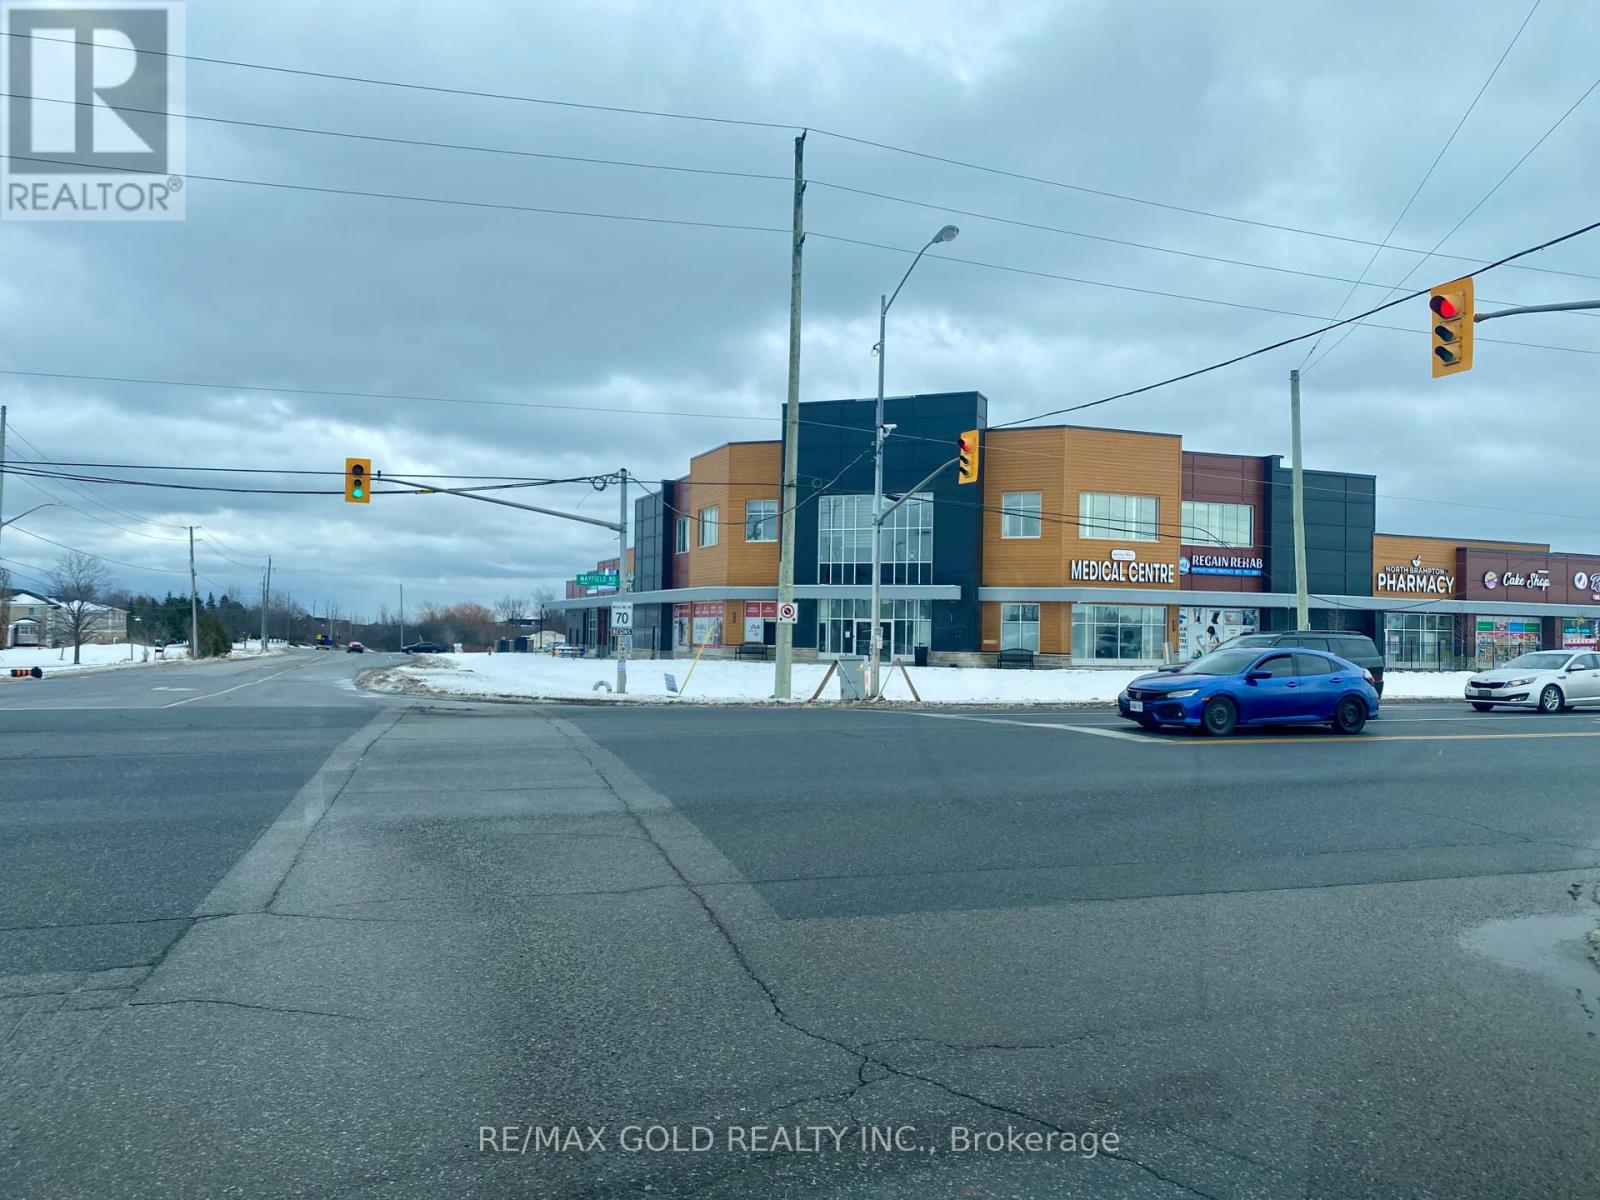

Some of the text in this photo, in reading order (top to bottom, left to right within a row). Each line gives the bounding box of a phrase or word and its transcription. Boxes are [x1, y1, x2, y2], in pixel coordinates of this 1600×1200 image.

[1192, 555, 1263, 569] REGAIN REHAB
[1071, 559, 1126, 582] MEDICAL
[1128, 562, 1175, 584] CENTRE
[1385, 566, 1445, 575] NORTH BRAMPTON
[1378, 573, 1455, 594] PHARMACY
[1503, 571, 1551, 591] Cake Shop
[615, 612, 629, 624] 70
[612, 628, 631, 636] BEGINS
